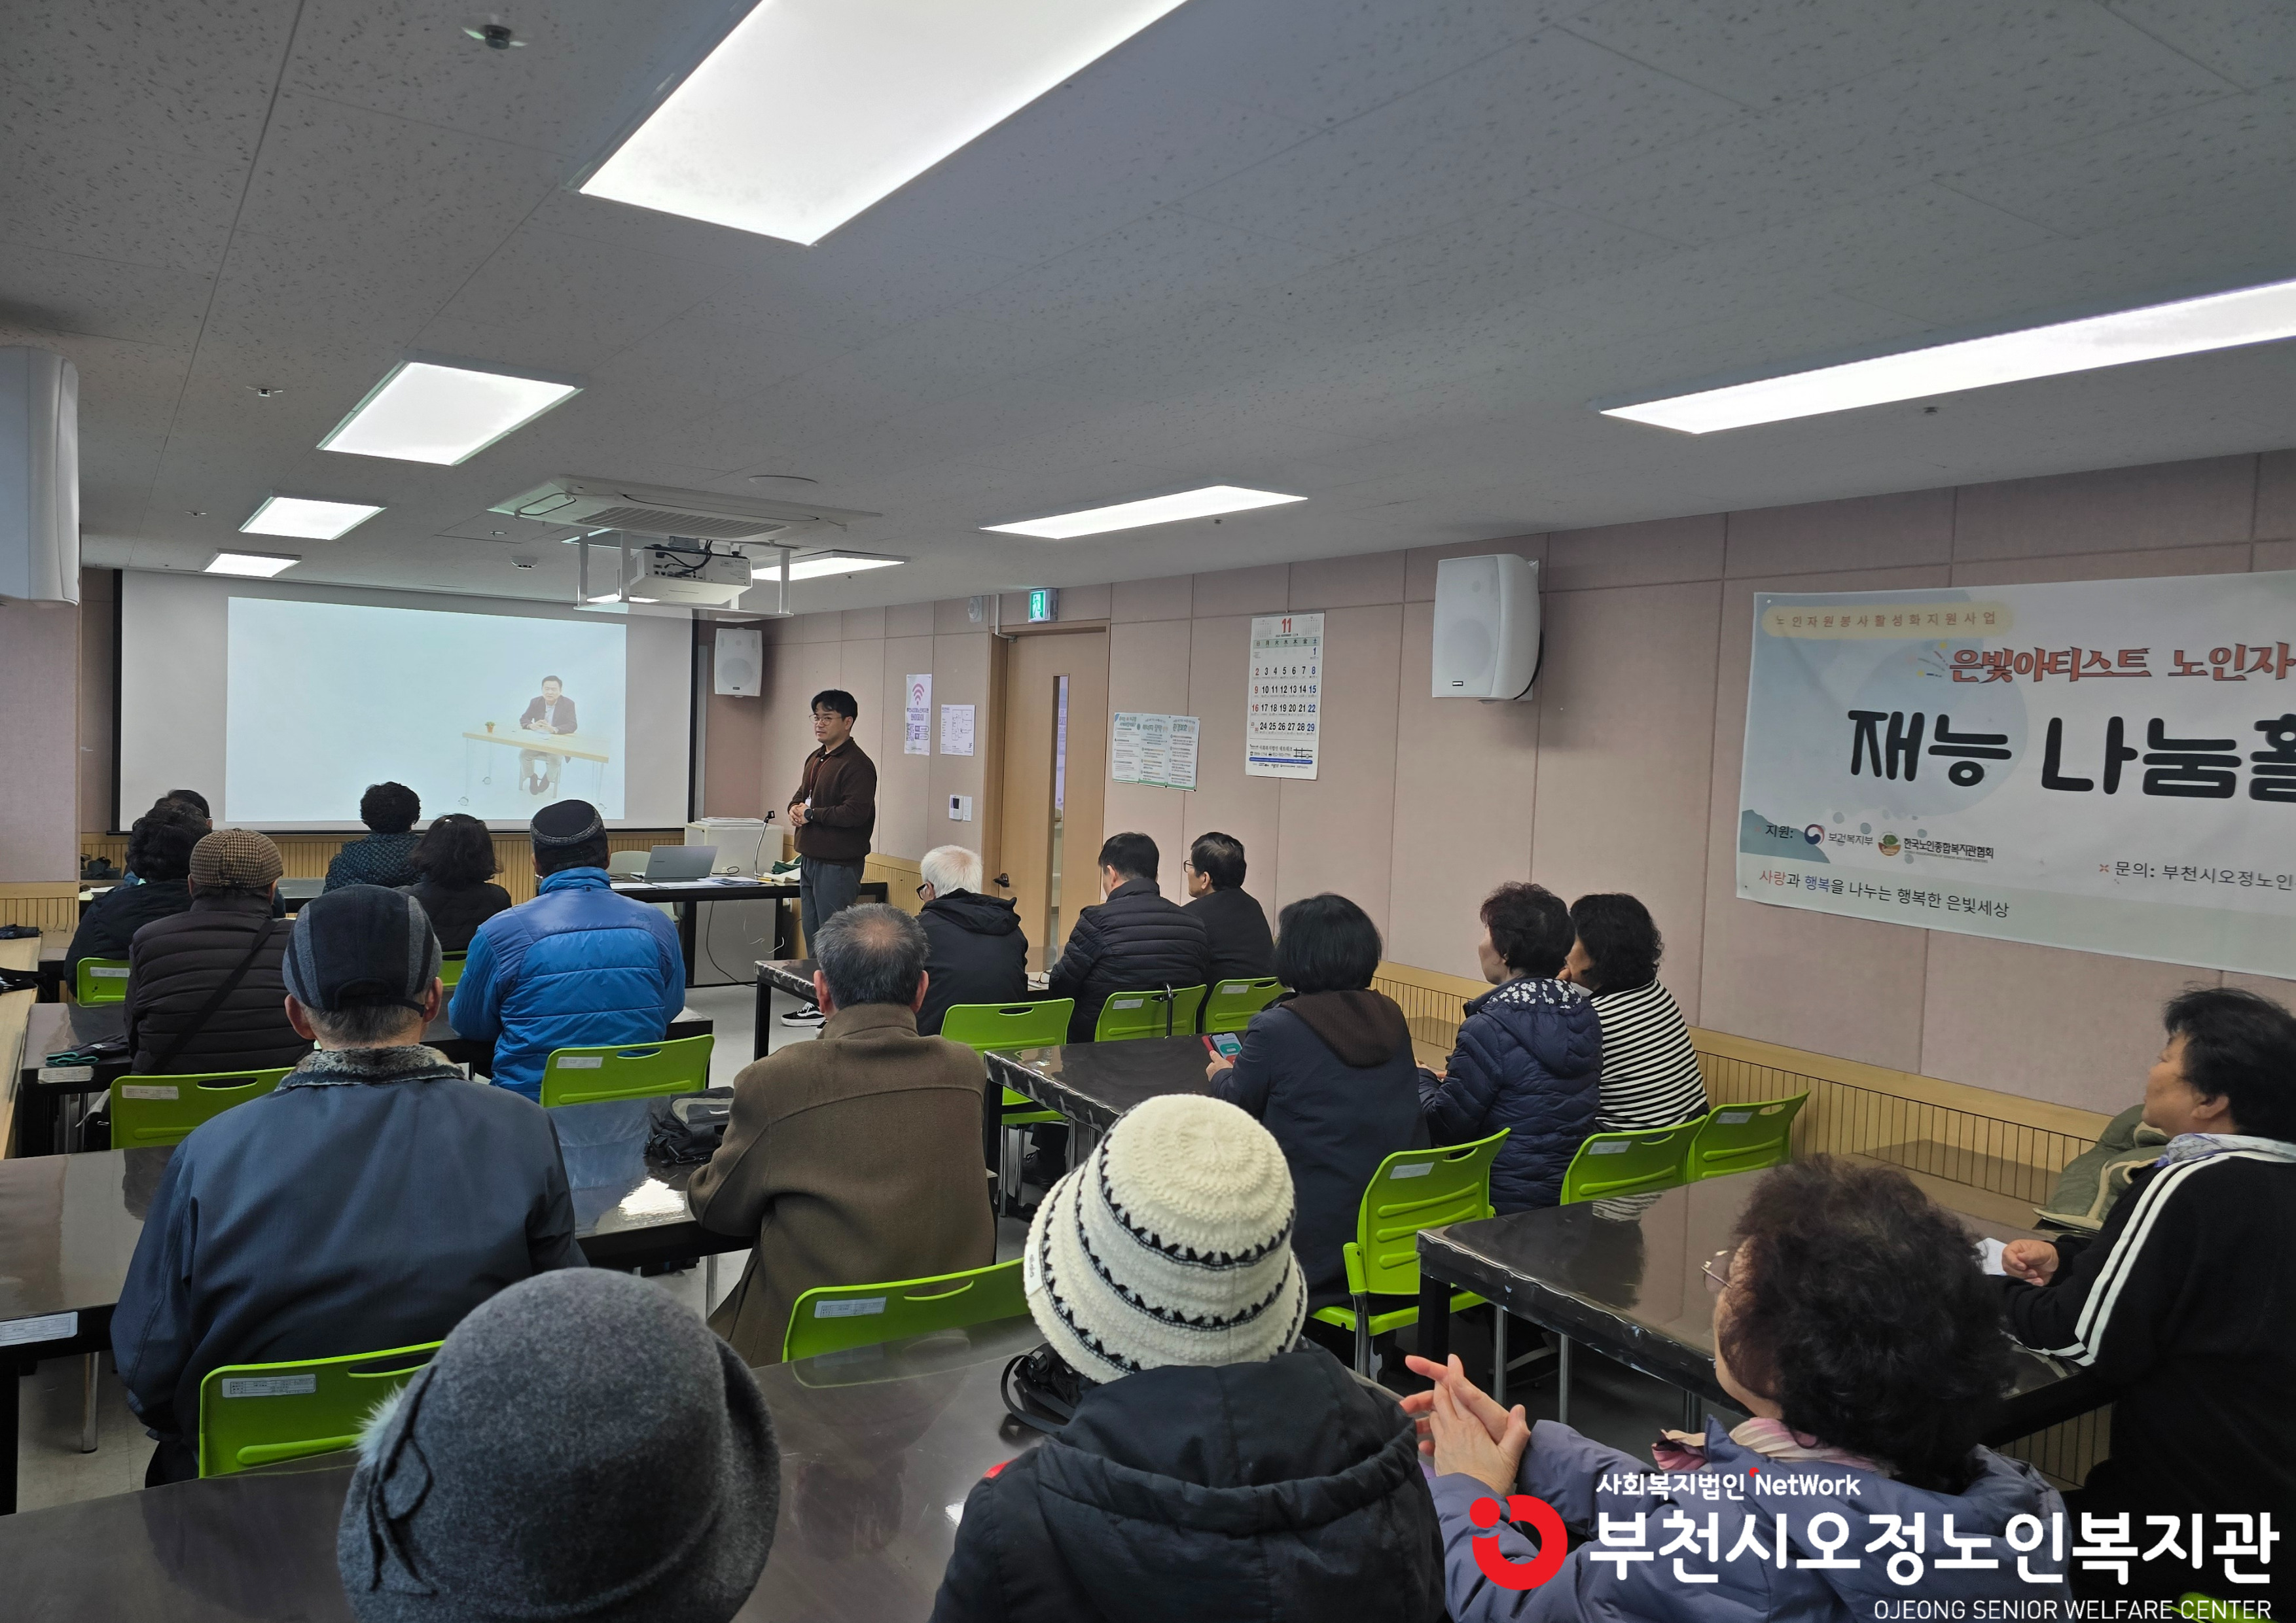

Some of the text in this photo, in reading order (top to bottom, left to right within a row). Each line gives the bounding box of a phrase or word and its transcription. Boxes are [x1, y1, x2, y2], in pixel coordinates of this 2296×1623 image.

[1282, 618, 1291, 633] 11
[1776, 611, 1996, 628] 노인자원봉사활성화지원사업
[1313, 647, 1317, 655] 1
[1255, 668, 1259, 676] 2
[1265, 667, 1268, 675] 3
[1283, 666, 1287, 675] 5
[1292, 666, 1296, 675] 6
[1302, 666, 1306, 674] 7
[1312, 666, 1316, 675] 8
[1948, 646, 2153, 683] 은빛아티스트
[1262, 685, 1269, 694] 10
[1272, 685, 1278, 694] 11
[1280, 685, 1287, 694] 12
[1289, 685, 1297, 694] 13
[1299, 685, 1306, 694] 14
[1309, 685, 1316, 694] 15
[1251, 704, 1316, 713] 16 17 18 19 20 21 22
[1260, 722, 1267, 730] 24
[1269, 722, 1276, 730] 25
[1287, 722, 1295, 731] 27
[1297, 722, 1305, 731] 28
[1307, 723, 1315, 732] 29
[1848, 710, 2012, 787] 재능
[1765, 825, 1793, 839] 지원:
[1829, 833, 1873, 846] 보건복지부
[1904, 838, 1994, 859] 한국노인종합복지관협회
[2115, 861, 2155, 878] 문의:
[1759, 870, 2009, 918] 사랑과 행복을 나누는 행복한 은빛세상
